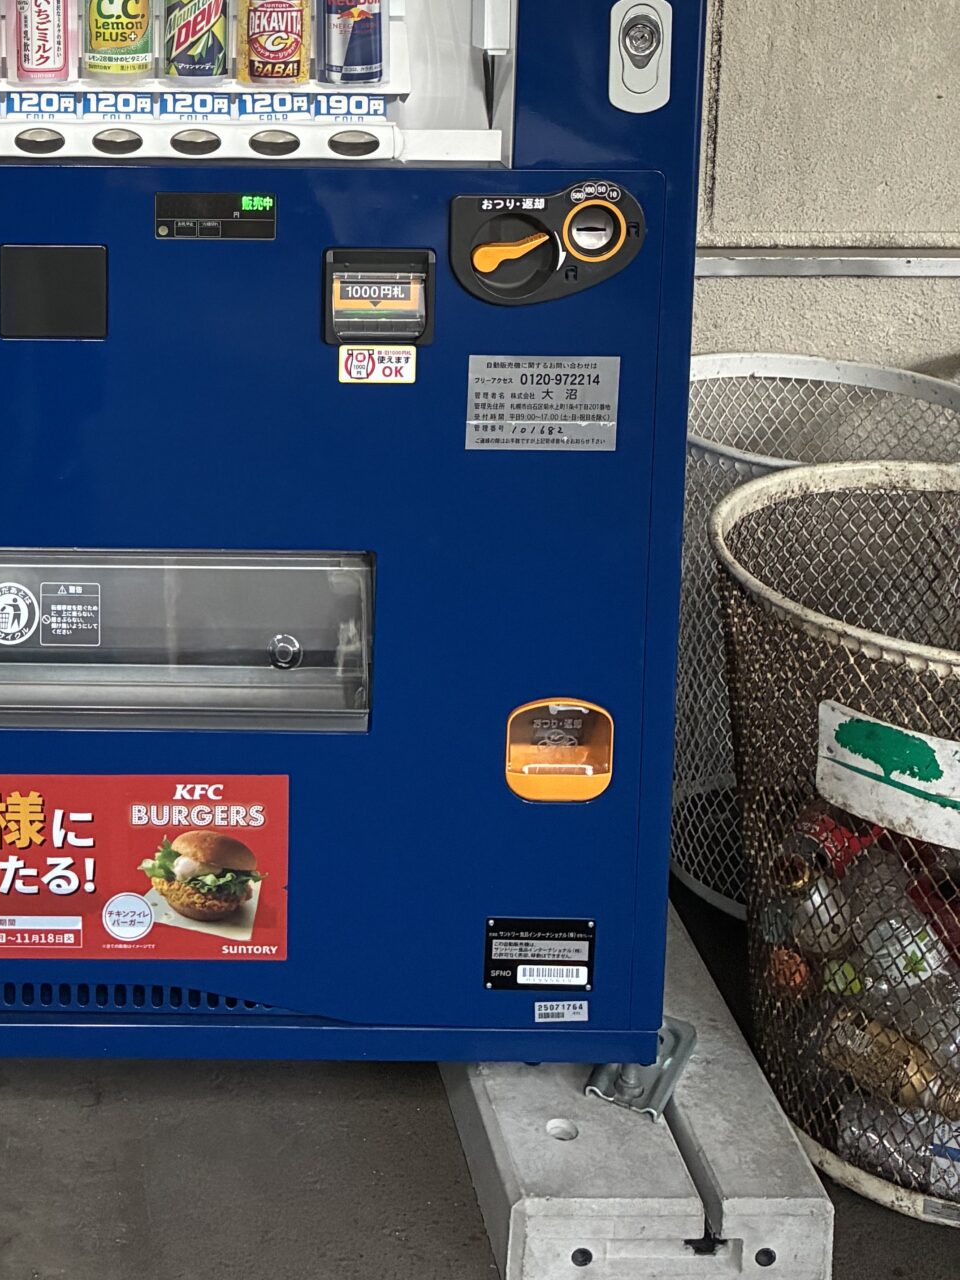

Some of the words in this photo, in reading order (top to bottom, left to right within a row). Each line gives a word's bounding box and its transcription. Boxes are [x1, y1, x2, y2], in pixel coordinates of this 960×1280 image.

[95, 18, 144, 31] Lemon
[249, 10, 302, 36] DEKAVITA
[10, 93, 75, 113] 120円
[86, 93, 151, 113] 120円
[164, 94, 229, 114] 120円
[243, 94, 308, 114] 120円
[318, 95, 384, 115] 190円
[584, 186, 595, 194] 100
[241, 195, 273, 211] 販売中
[481, 198, 545, 210] おつり・返却
[346, 286, 405, 298] 1000円札
[377, 356, 411, 364] 使えます
[486, 361, 597, 370] 自動販売機に関するお問い合わせは
[382, 366, 404, 378] OK
[520, 373, 600, 386] 0120-972214
[474, 391, 505, 400] 管理者名
[510, 392, 535, 400] 株式会社
[173, 783, 224, 801] KFC
[131, 803, 266, 827] BURGERS
[107, 910, 150, 918] チキンフィレ
[112, 919, 145, 927] バーガー
[221, 944, 278, 956] SUNTORY
